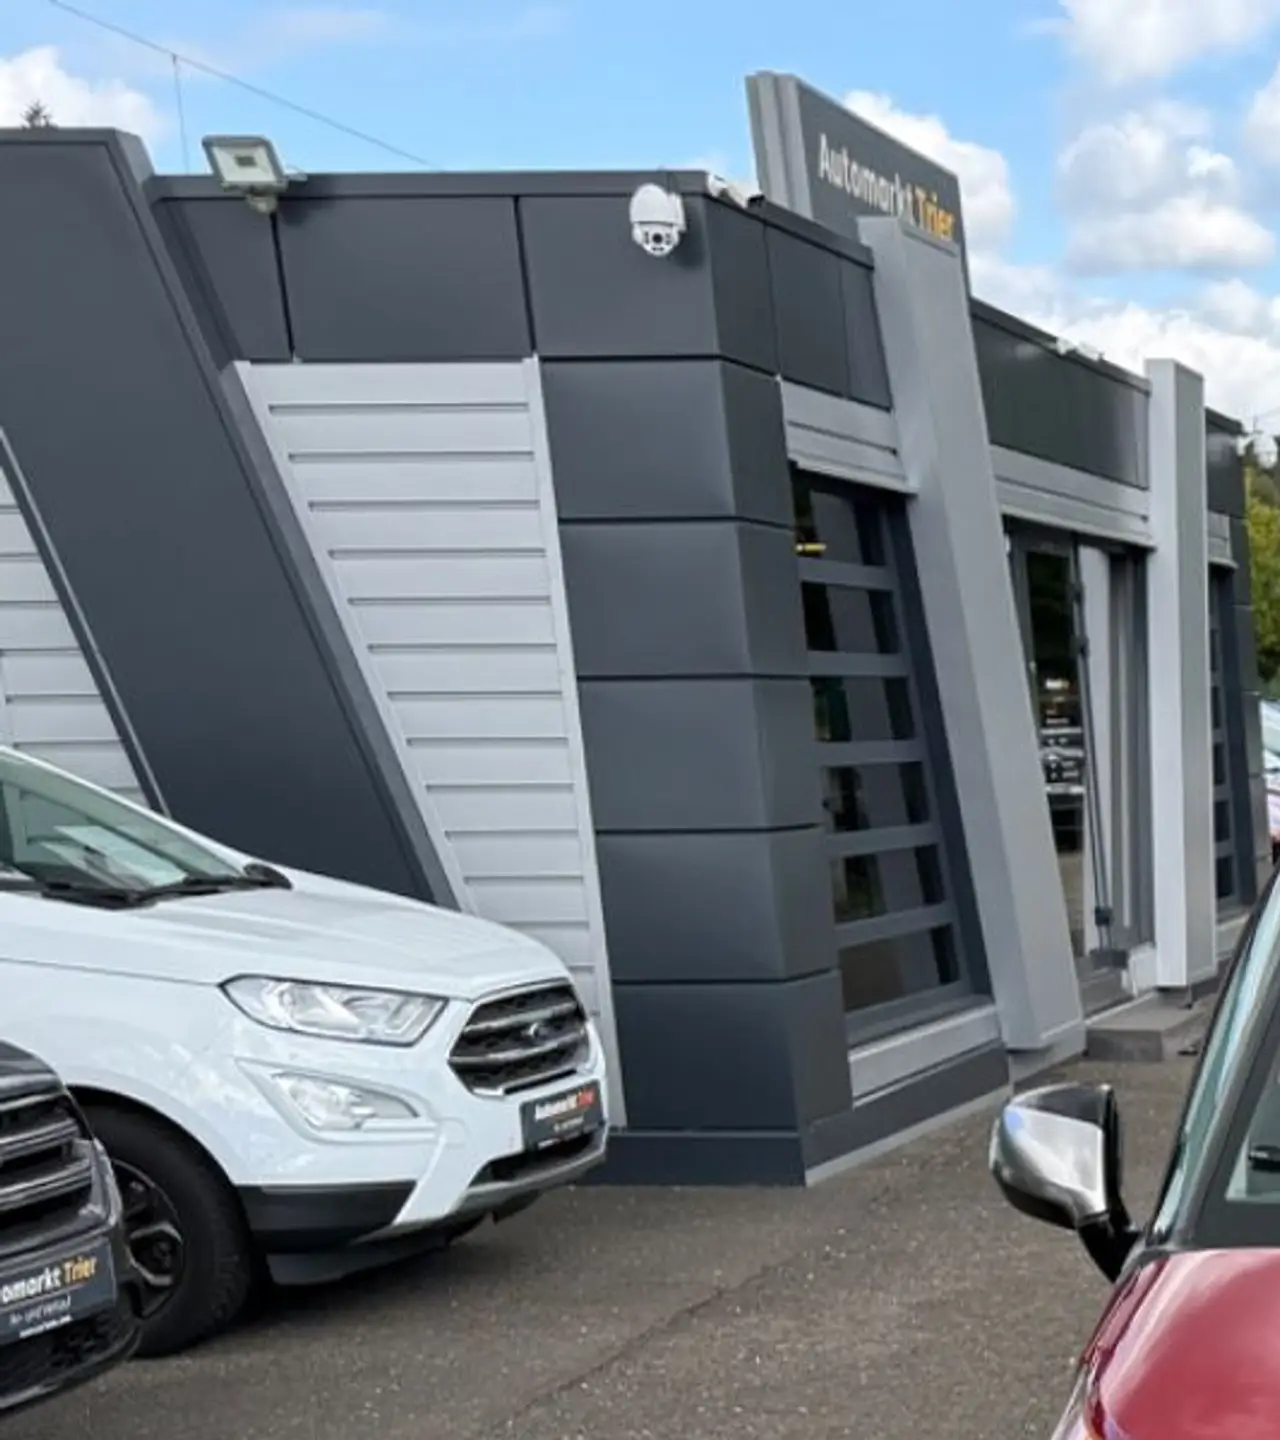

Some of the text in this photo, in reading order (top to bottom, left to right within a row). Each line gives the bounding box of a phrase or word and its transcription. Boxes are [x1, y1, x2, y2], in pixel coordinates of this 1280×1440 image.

[819, 132, 956, 242] Automarkt Trier
[0, 1267, 61, 1304] omarkt
